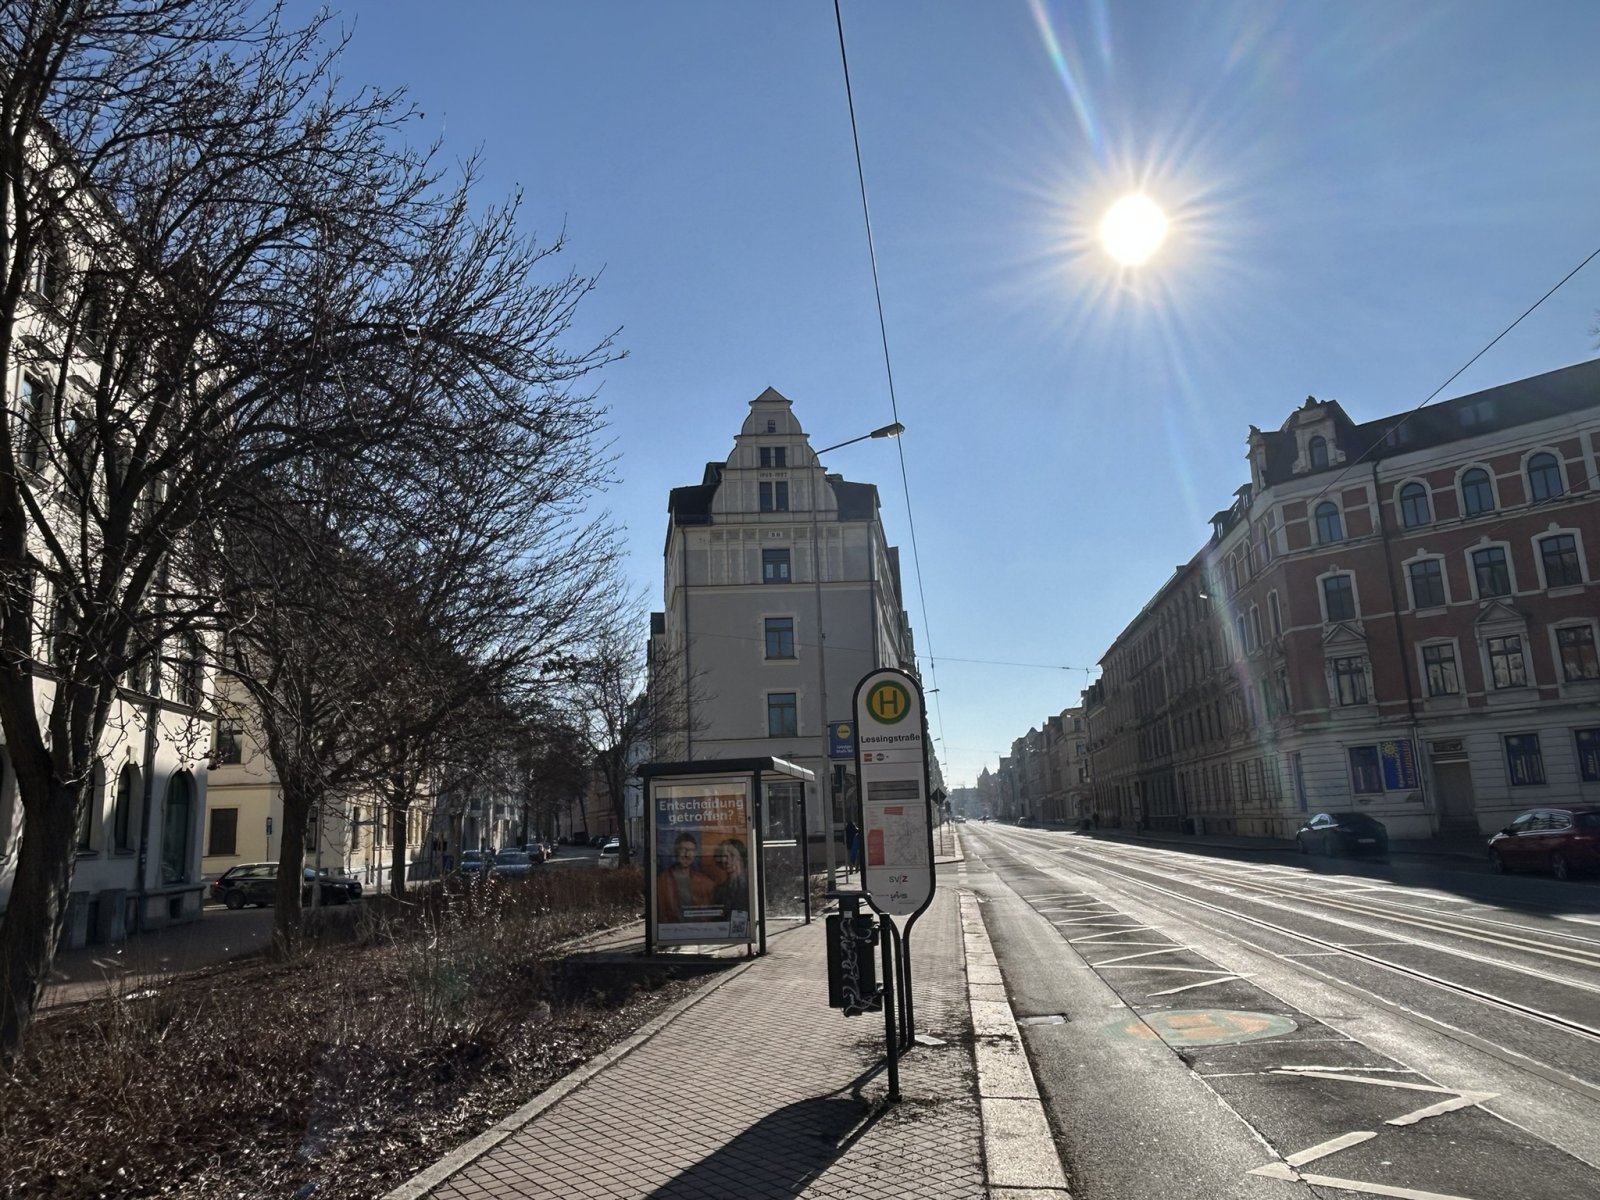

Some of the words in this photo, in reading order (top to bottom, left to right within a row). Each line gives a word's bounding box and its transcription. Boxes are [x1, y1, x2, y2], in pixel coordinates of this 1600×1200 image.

[879, 690, 898, 715] H
[860, 733, 920, 744] Lessingstraße
[659, 798, 744, 811] Entscheidung
[668, 810, 734, 825] getroffen?
